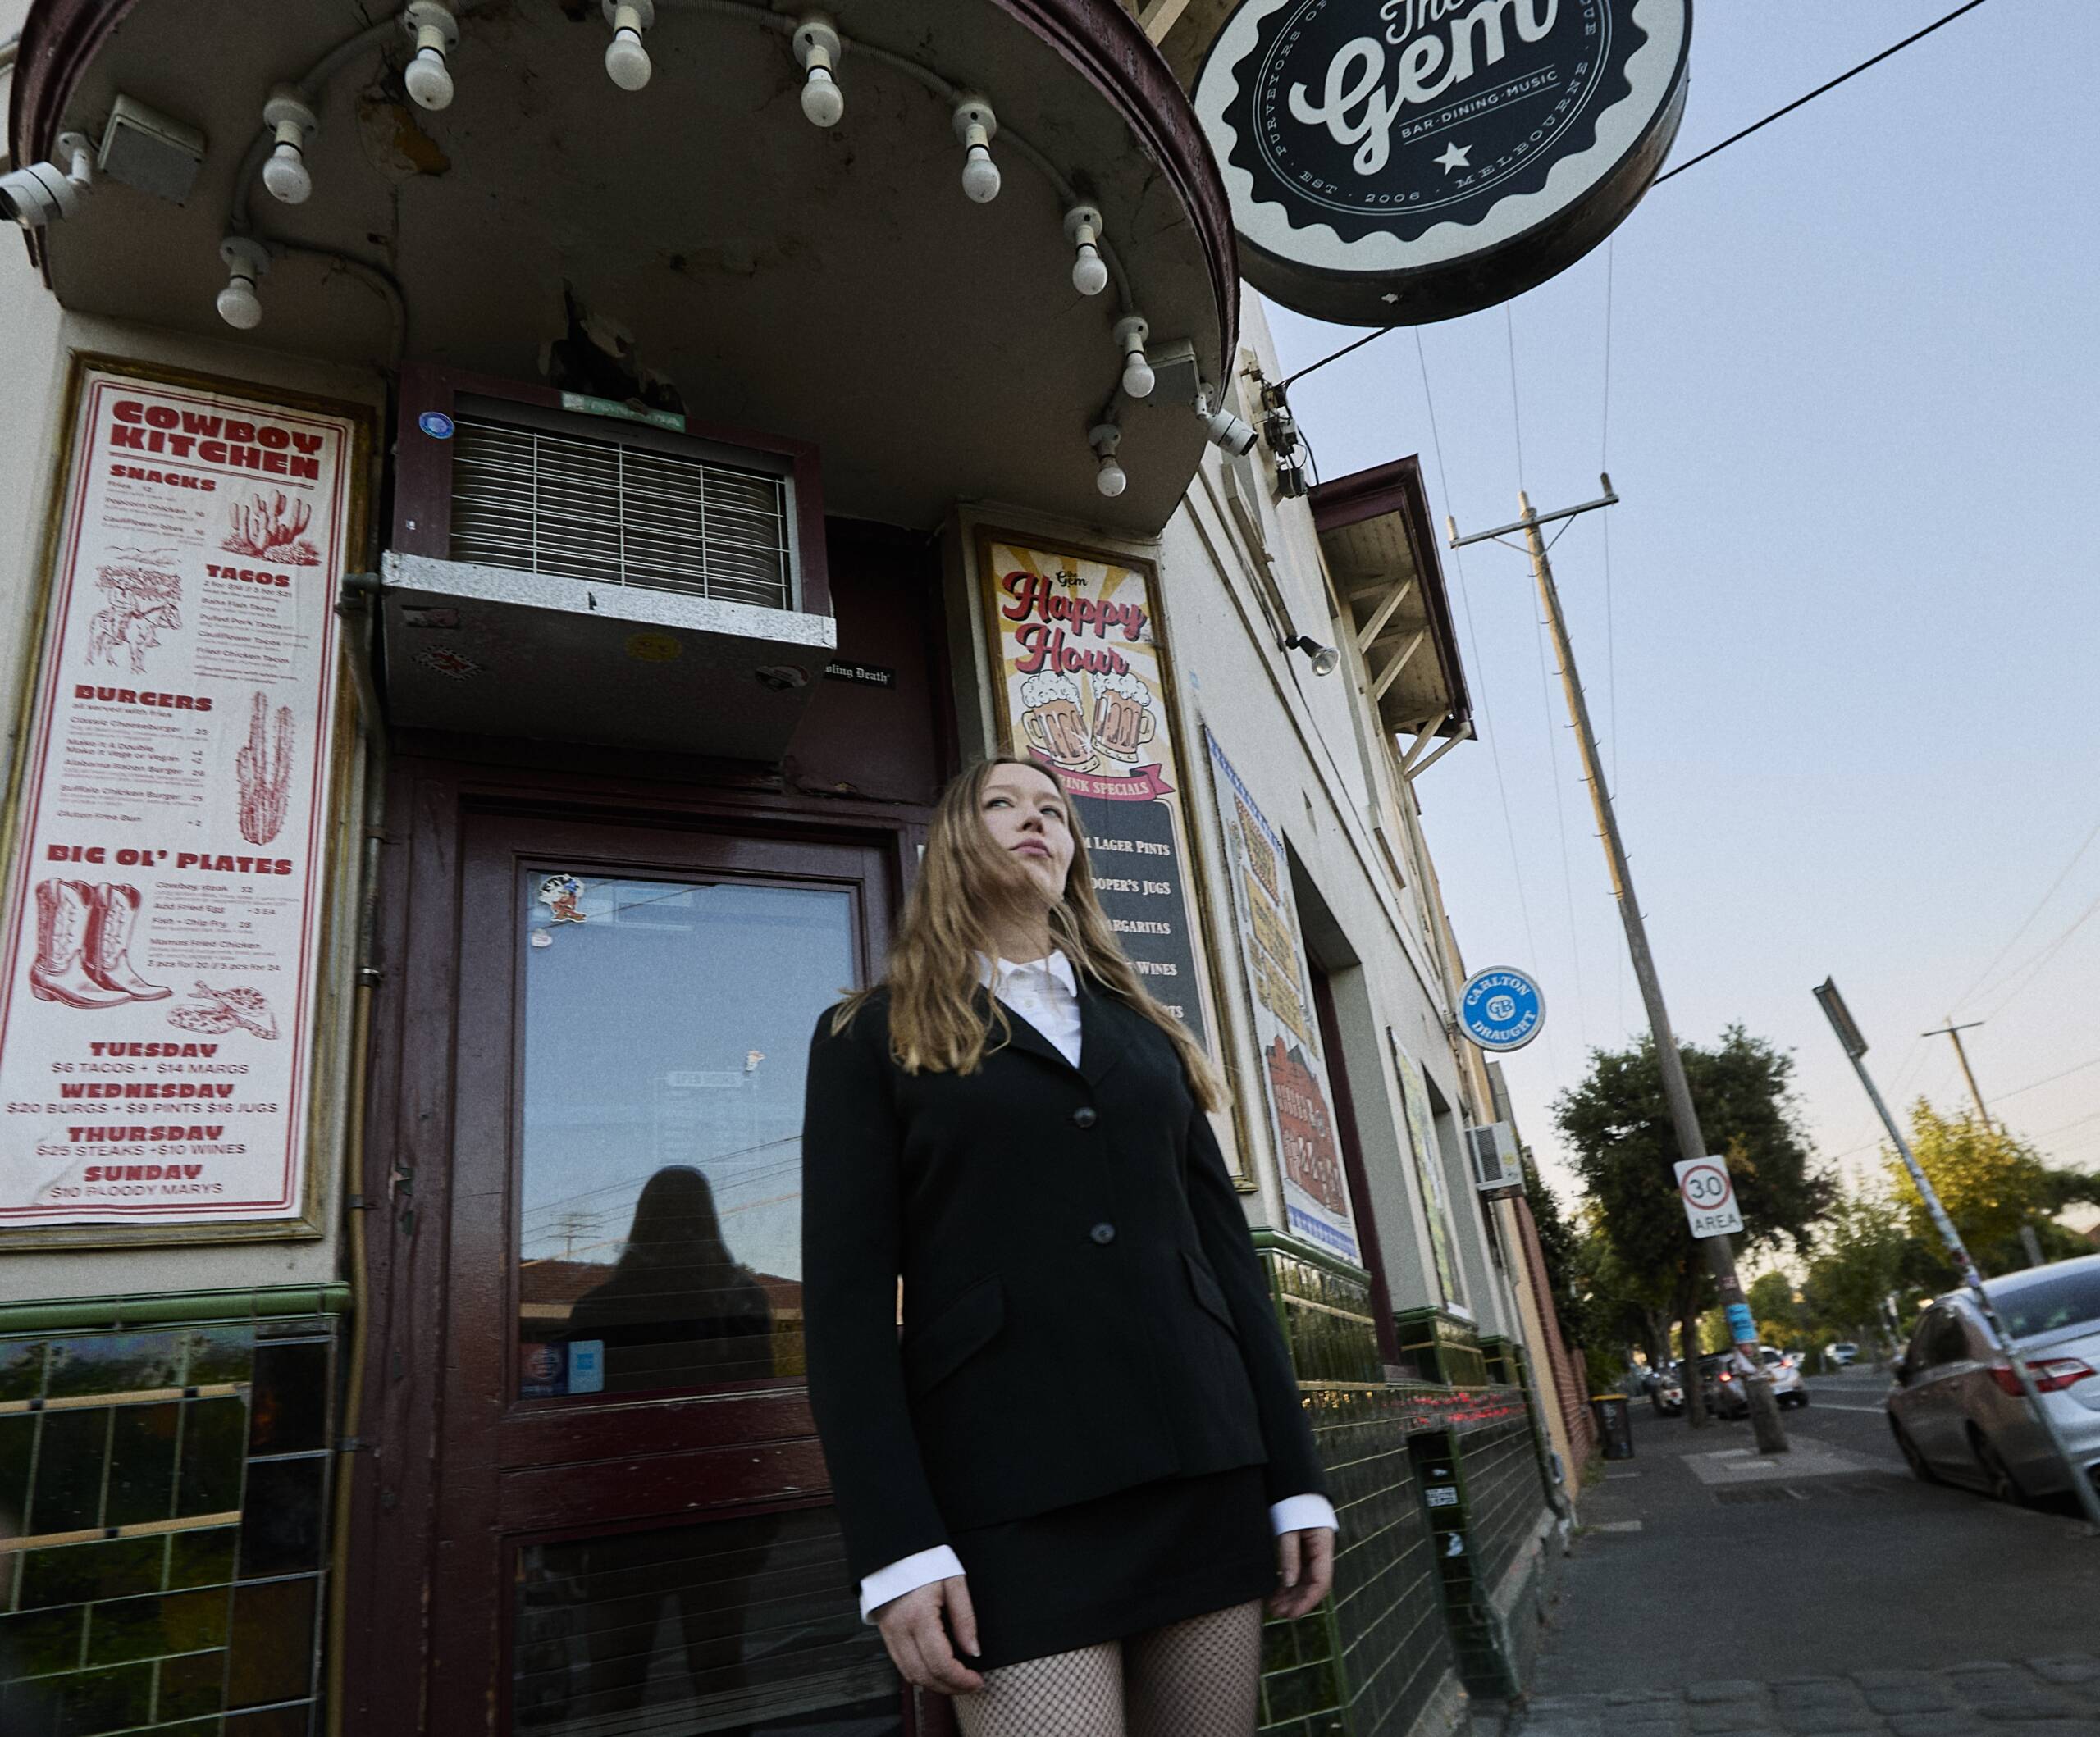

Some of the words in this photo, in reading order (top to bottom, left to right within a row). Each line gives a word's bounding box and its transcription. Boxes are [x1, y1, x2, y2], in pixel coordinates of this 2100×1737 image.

[1267, 31, 1300, 157] PURVEYORS
[1288, 0, 1559, 176] Gem
[1299, 171, 1338, 195] EST
[1365, 191, 1421, 203] 2006
[1455, 61, 1588, 189] MELBOURNE
[112, 400, 324, 456] COWBOY
[109, 424, 321, 481] KITCHEN
[109, 464, 217, 492] SNACKS
[206, 563, 290, 588] TACOS
[1055, 570, 1088, 588] Gem
[1002, 571, 1148, 641] Happy
[1014, 622, 1130, 676] Hour
[825, 663, 854, 679] oling
[75, 684, 213, 712] BURGERS
[1061, 776, 1090, 793] INK
[1092, 781, 1150, 796] SPECIALS
[1093, 837, 1134, 853] LAGER
[1135, 841, 1171, 856] PINTS
[47, 844, 106, 864] BIG
[116, 848, 169, 868] OL'
[176, 852, 294, 875] PLATES
[1091, 877, 1139, 892] OOPER'S
[1142, 880, 1171, 896] JUGS
[1107, 919, 1171, 935] ARGARITAS
[1135, 960, 1178, 976] WINES
[1467, 976, 1531, 1006] CARLTON
[1472, 1010, 1536, 1040] DRAUGHT
[89, 1042, 219, 1058] TUESDAY
[51, 1062, 75, 1074] $6
[78, 1063, 135, 1074] TACOS
[156, 1063, 185, 1074] $14
[188, 1063, 249, 1074] MARGS
[60, 1083, 235, 1099] WEDNESDAY
[7, 1103, 42, 1115] $20
[46, 1103, 108, 1115] BURGS
[126, 1103, 148, 1114] $9
[152, 1102, 203, 1114] PINTS
[237, 1102, 279, 1114] JUGS
[67, 1125, 225, 1142] THURSDAY
[36, 1144, 71, 1156] $25
[75, 1144, 145, 1156] STEAKS
[189, 1144, 247, 1156] WINES
[84, 1164, 204, 1183] SUNDAY
[49, 1187, 81, 1199] $10
[161, 1182, 225, 1196] MARYS
[1690, 1176, 1723, 1199] 30
[1695, 1214, 1737, 1232] AREA
